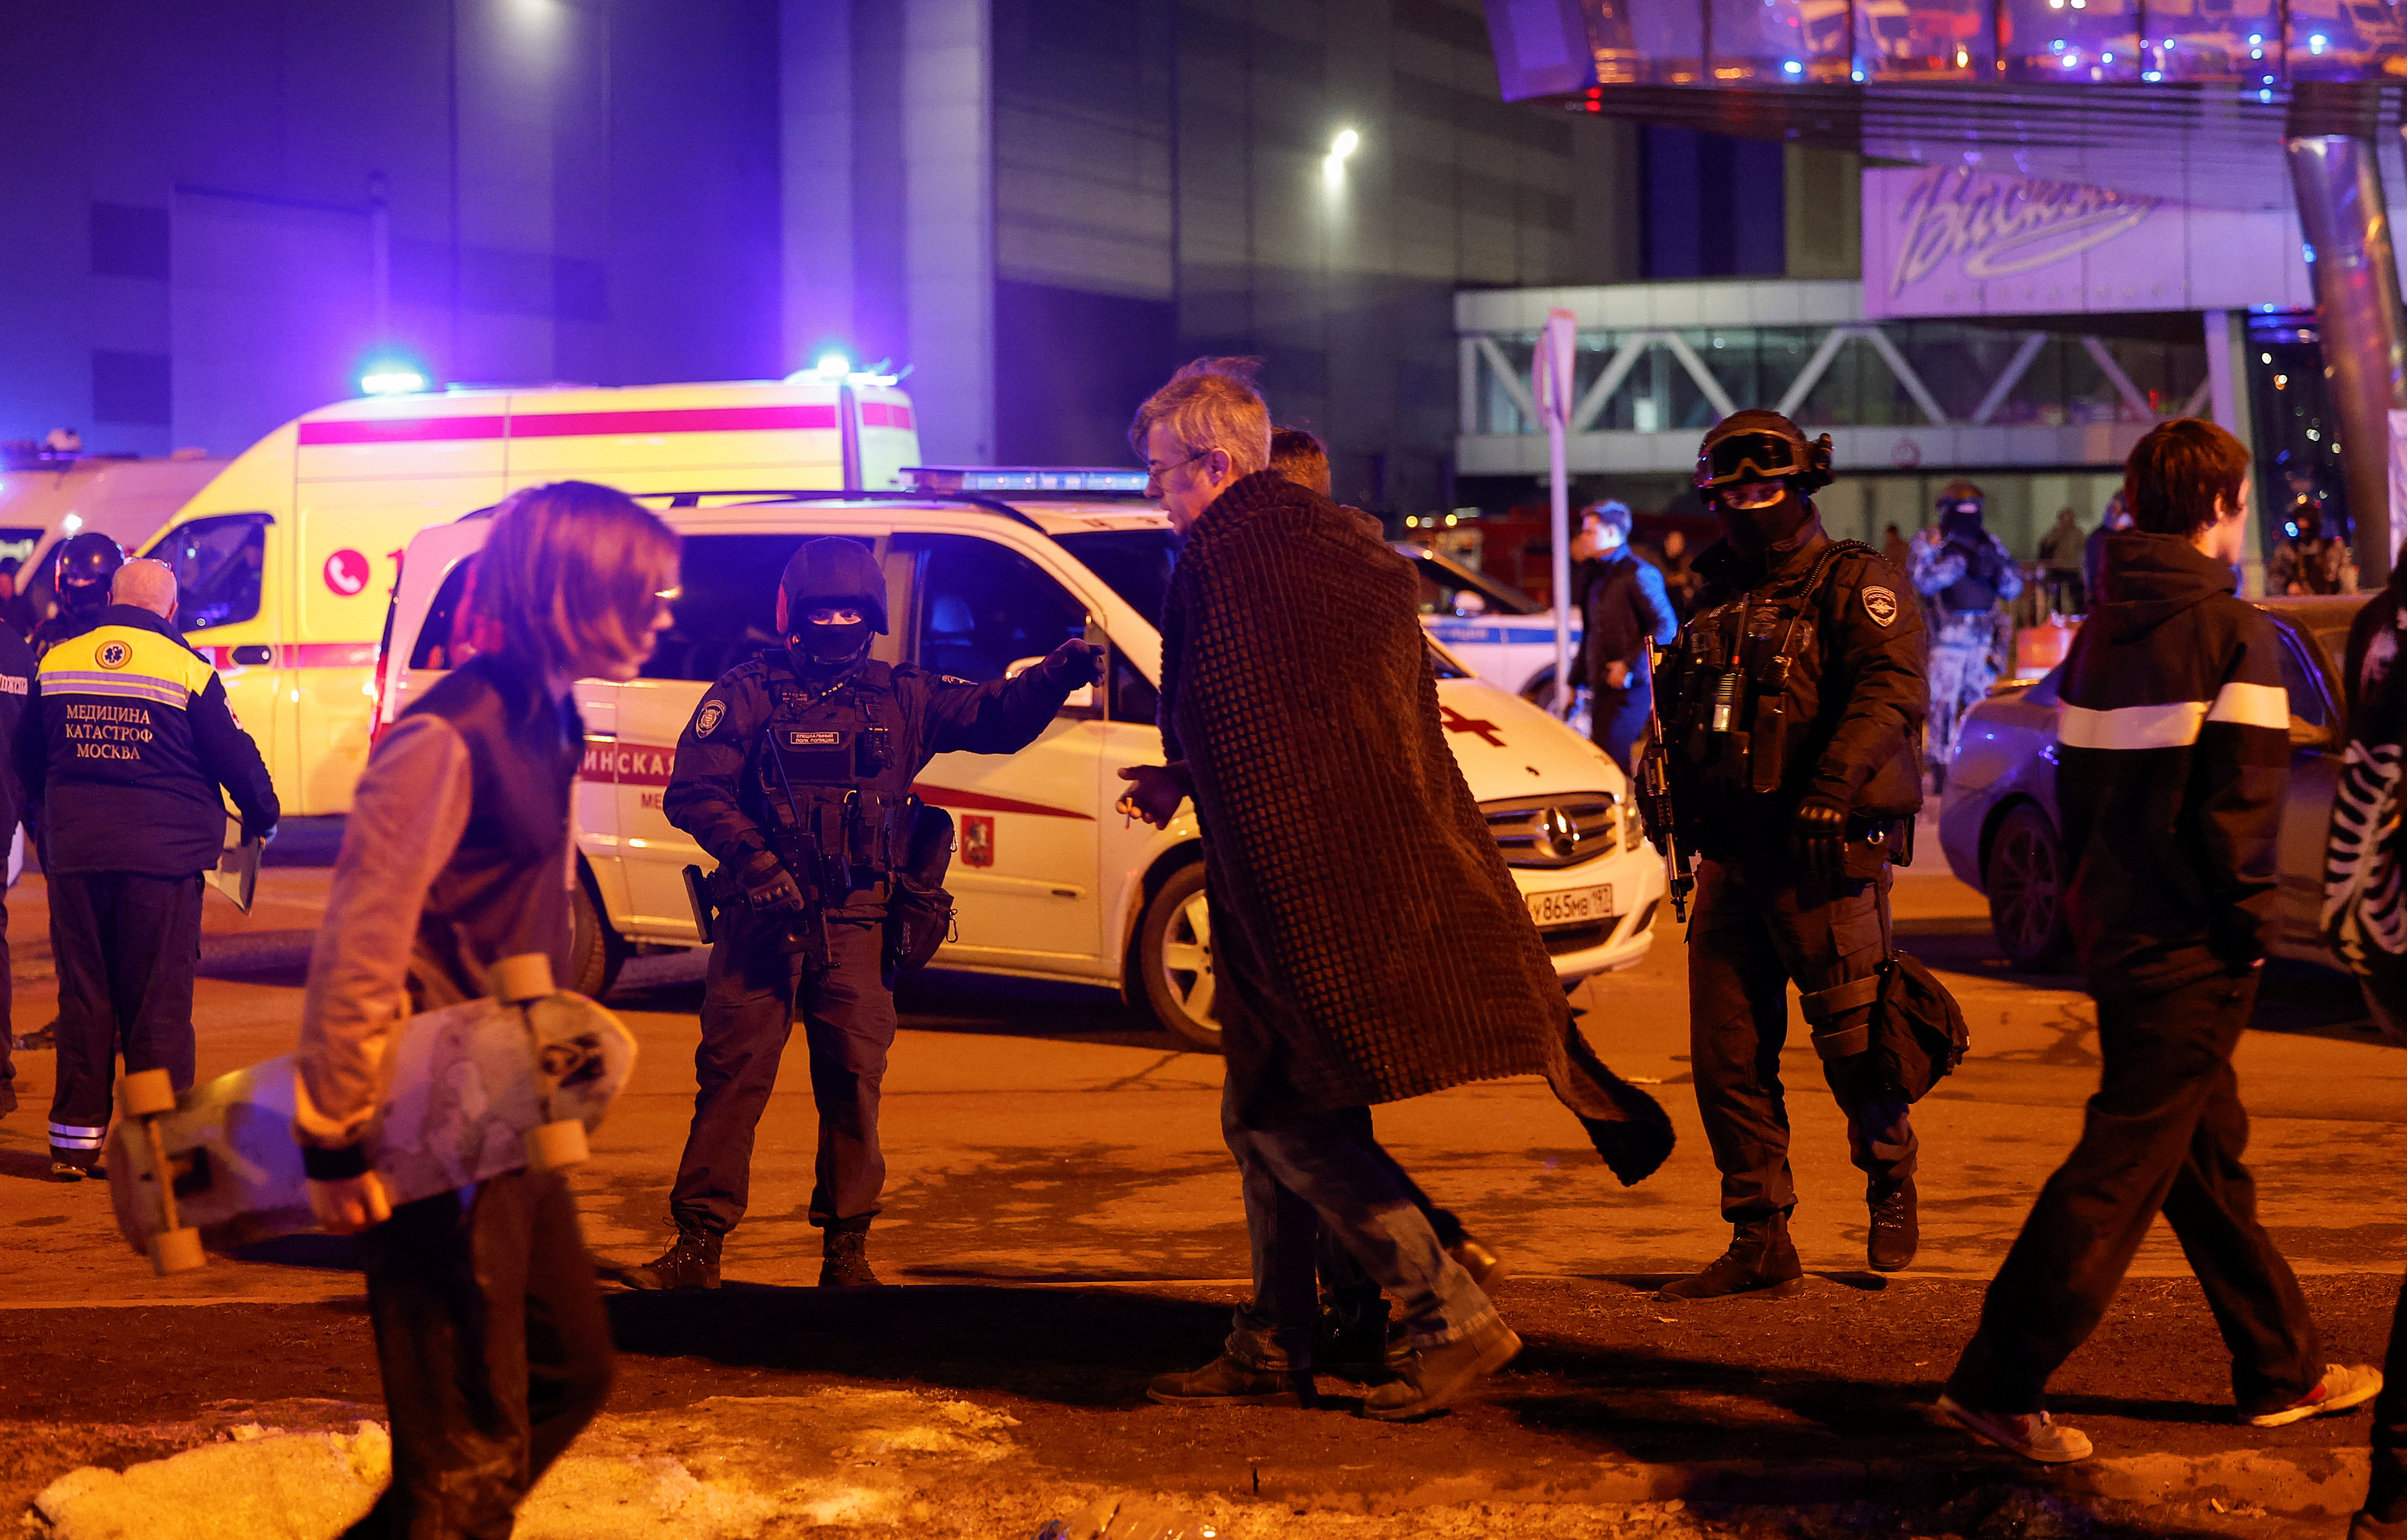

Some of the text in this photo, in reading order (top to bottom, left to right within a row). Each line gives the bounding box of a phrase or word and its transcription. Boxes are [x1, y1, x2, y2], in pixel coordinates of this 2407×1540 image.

[66, 704, 151, 724] МЕДИЦИНА
[65, 723, 153, 742] КАТАСТРОФ
[77, 743, 141, 760] МОСКВА
[582, 750, 675, 776] ИНСКА
